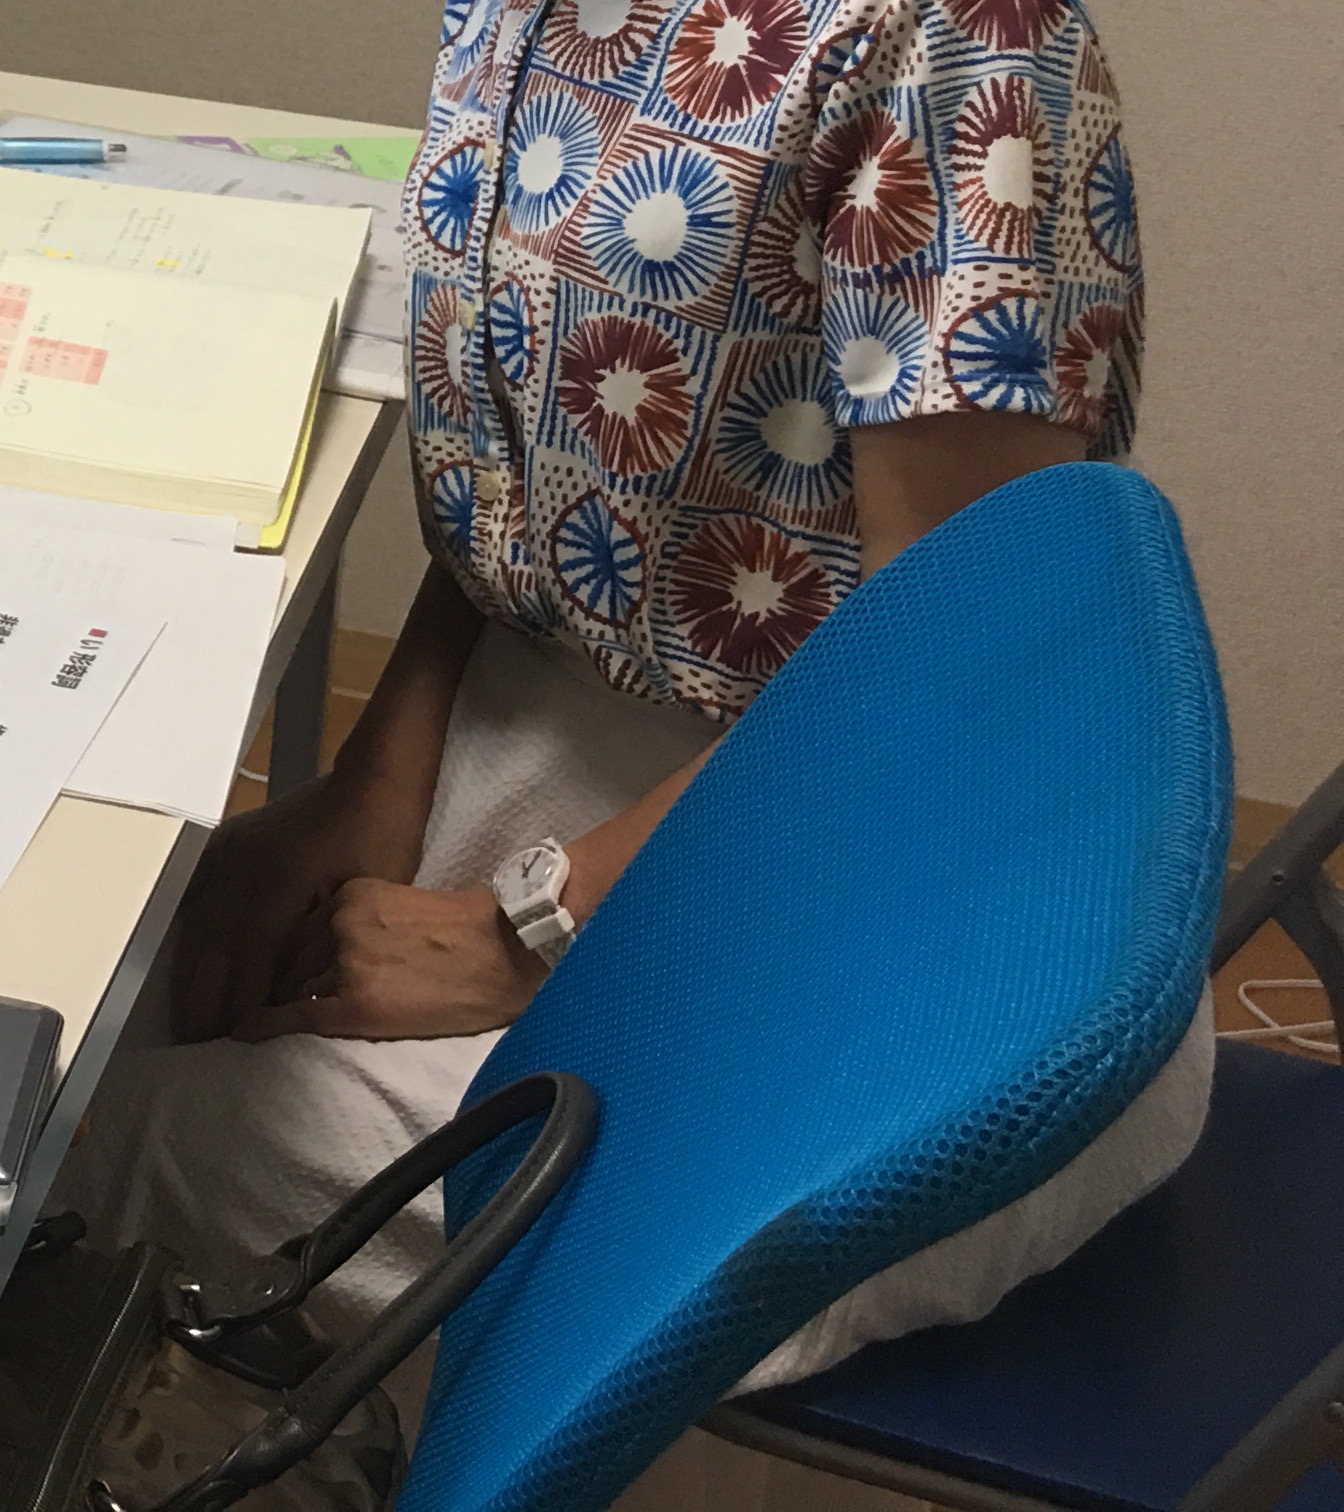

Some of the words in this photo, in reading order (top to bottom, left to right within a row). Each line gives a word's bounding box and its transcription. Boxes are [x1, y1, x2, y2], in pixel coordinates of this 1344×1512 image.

[77, 634, 106, 656] い
[50, 651, 97, 690] 形容詞
